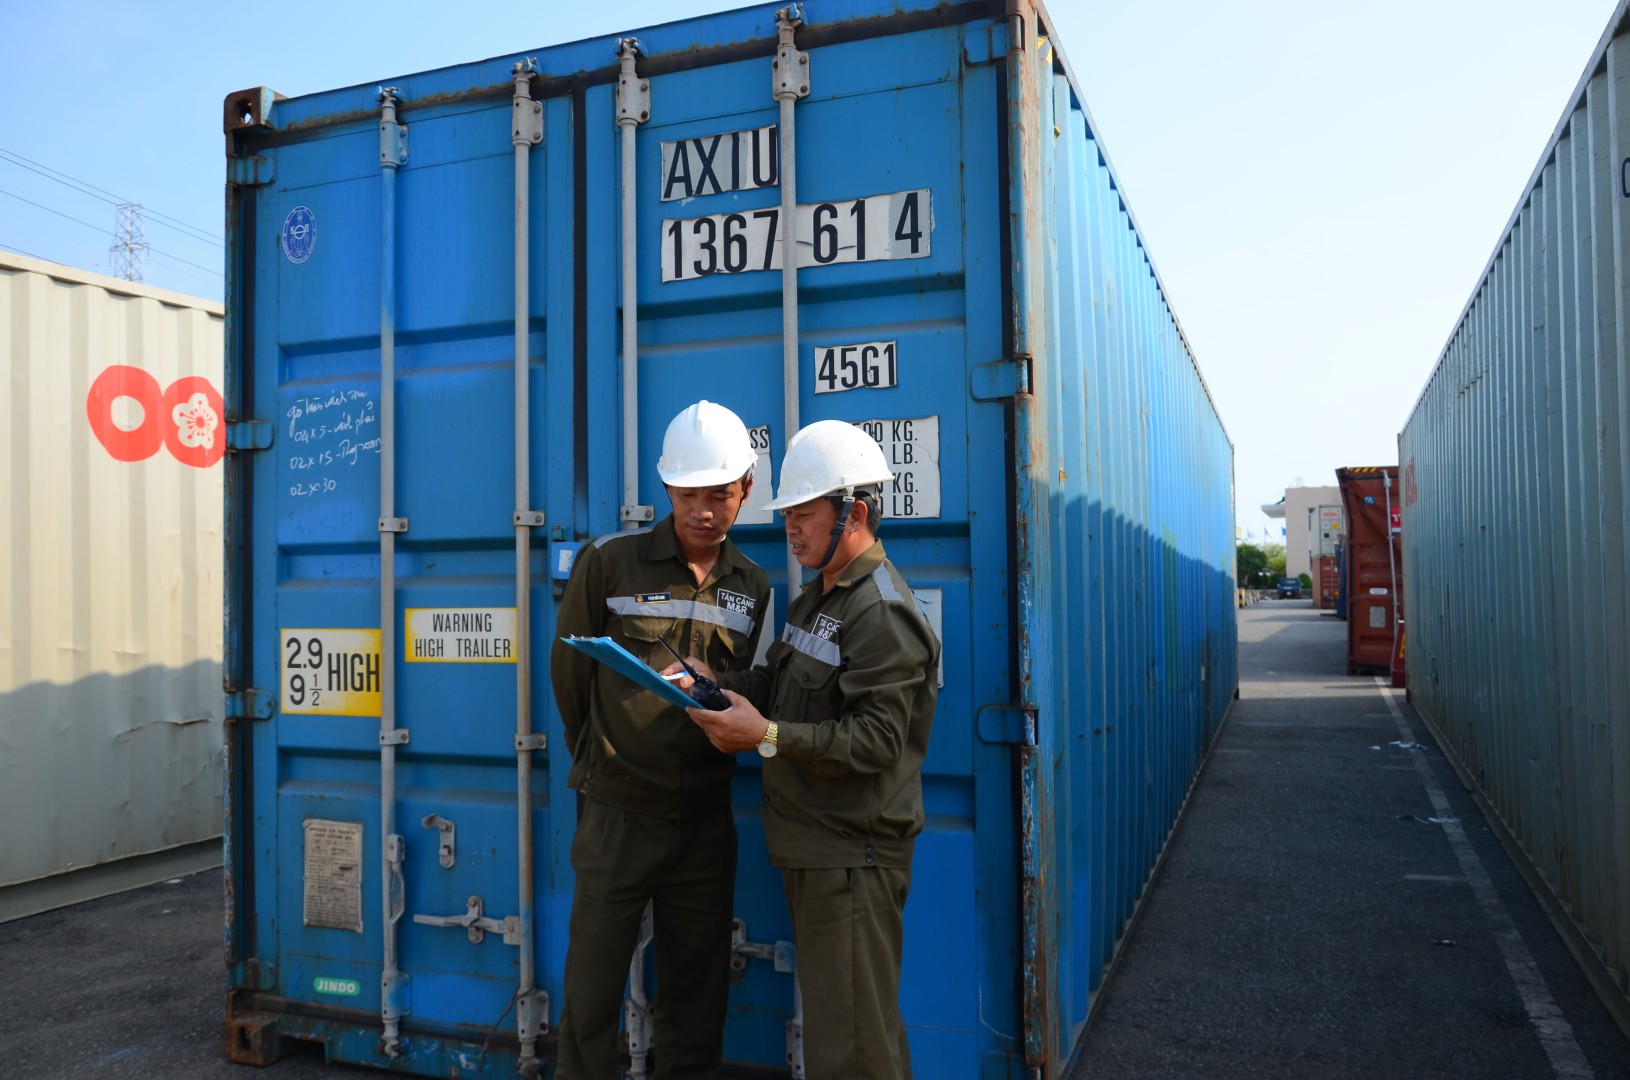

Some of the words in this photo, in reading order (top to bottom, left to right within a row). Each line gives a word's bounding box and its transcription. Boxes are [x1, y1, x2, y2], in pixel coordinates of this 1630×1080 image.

[664, 127, 777, 199] AXIU
[895, 192, 922, 254] 4
[818, 343, 895, 390] 45G1
[852, 421, 884, 443] 00
[892, 420, 918, 442] KG.
[892, 443, 918, 465] LB.
[892, 471, 919, 494] KG.
[892, 494, 919, 517] LB.
[726, 602, 748, 615] M&R
[432, 612, 493, 633] WARNING
[415, 638, 444, 658] HIGH
[456, 638, 511, 658] TRAILER
[327, 653, 380, 693] HIGH
[318, 980, 356, 994] JINDO
